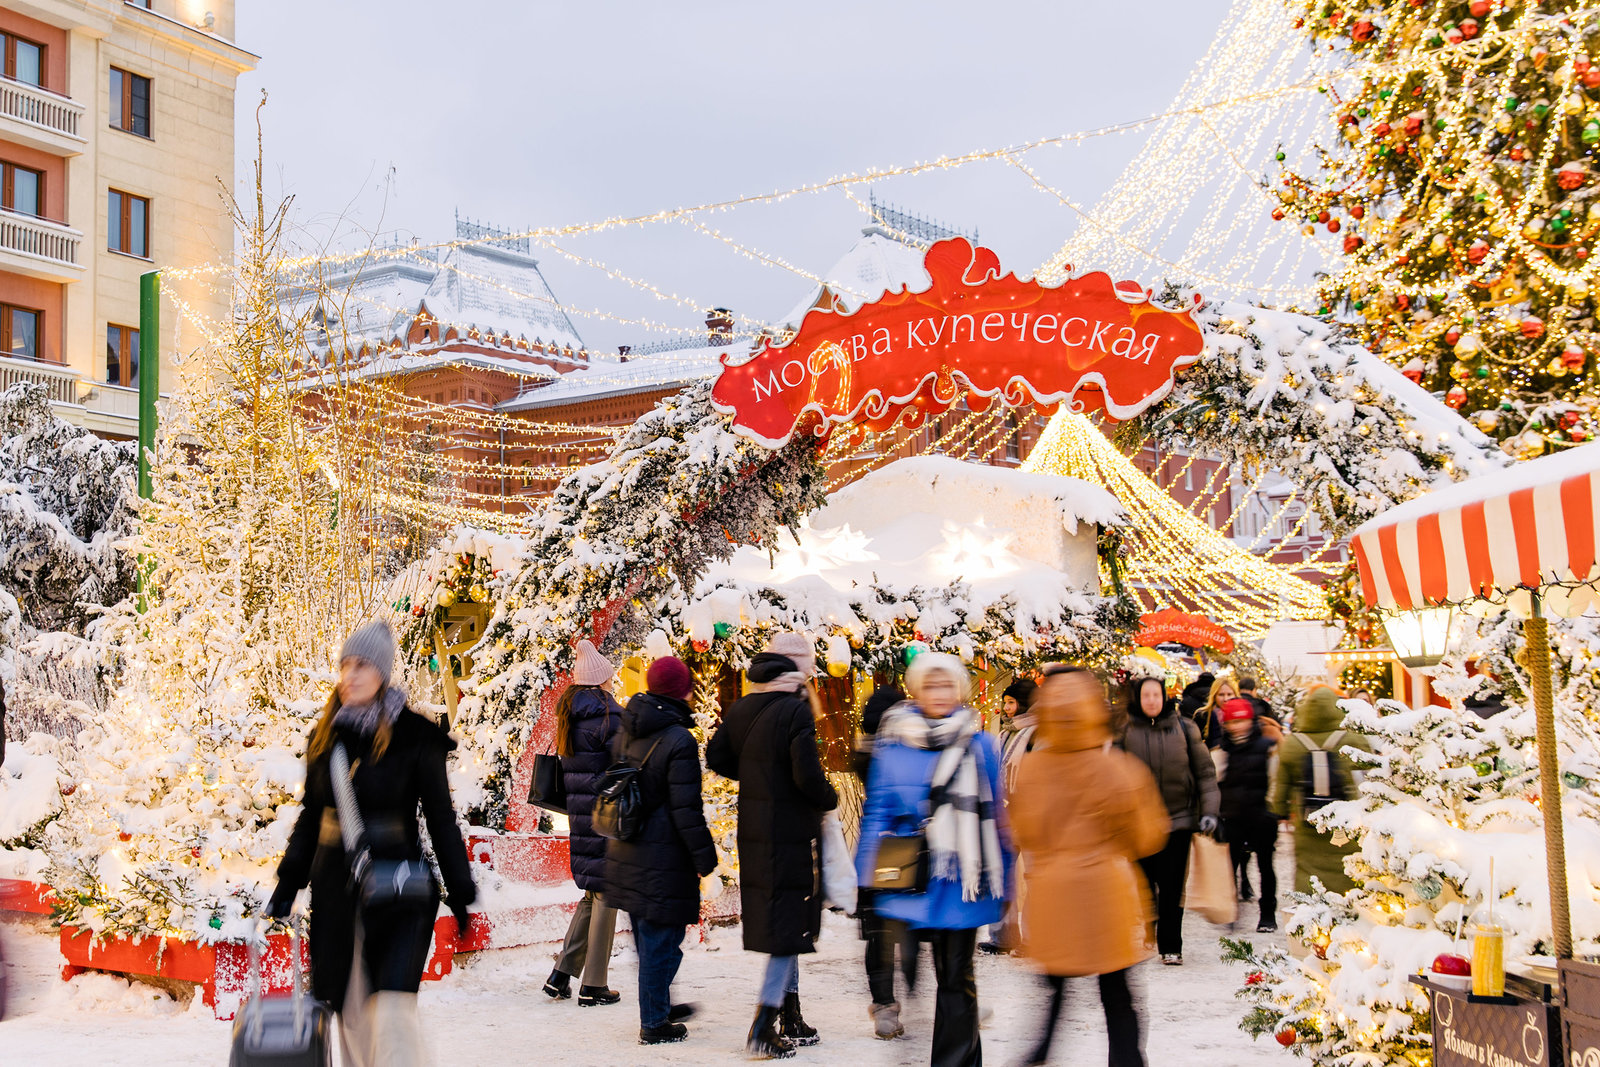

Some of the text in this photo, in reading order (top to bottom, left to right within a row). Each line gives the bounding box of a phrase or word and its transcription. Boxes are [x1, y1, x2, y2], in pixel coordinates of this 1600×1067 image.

[906, 311, 1161, 365] купеческая
[1443, 1028, 1478, 1061] Яблоки
[1478, 1046, 1486, 1064] в
